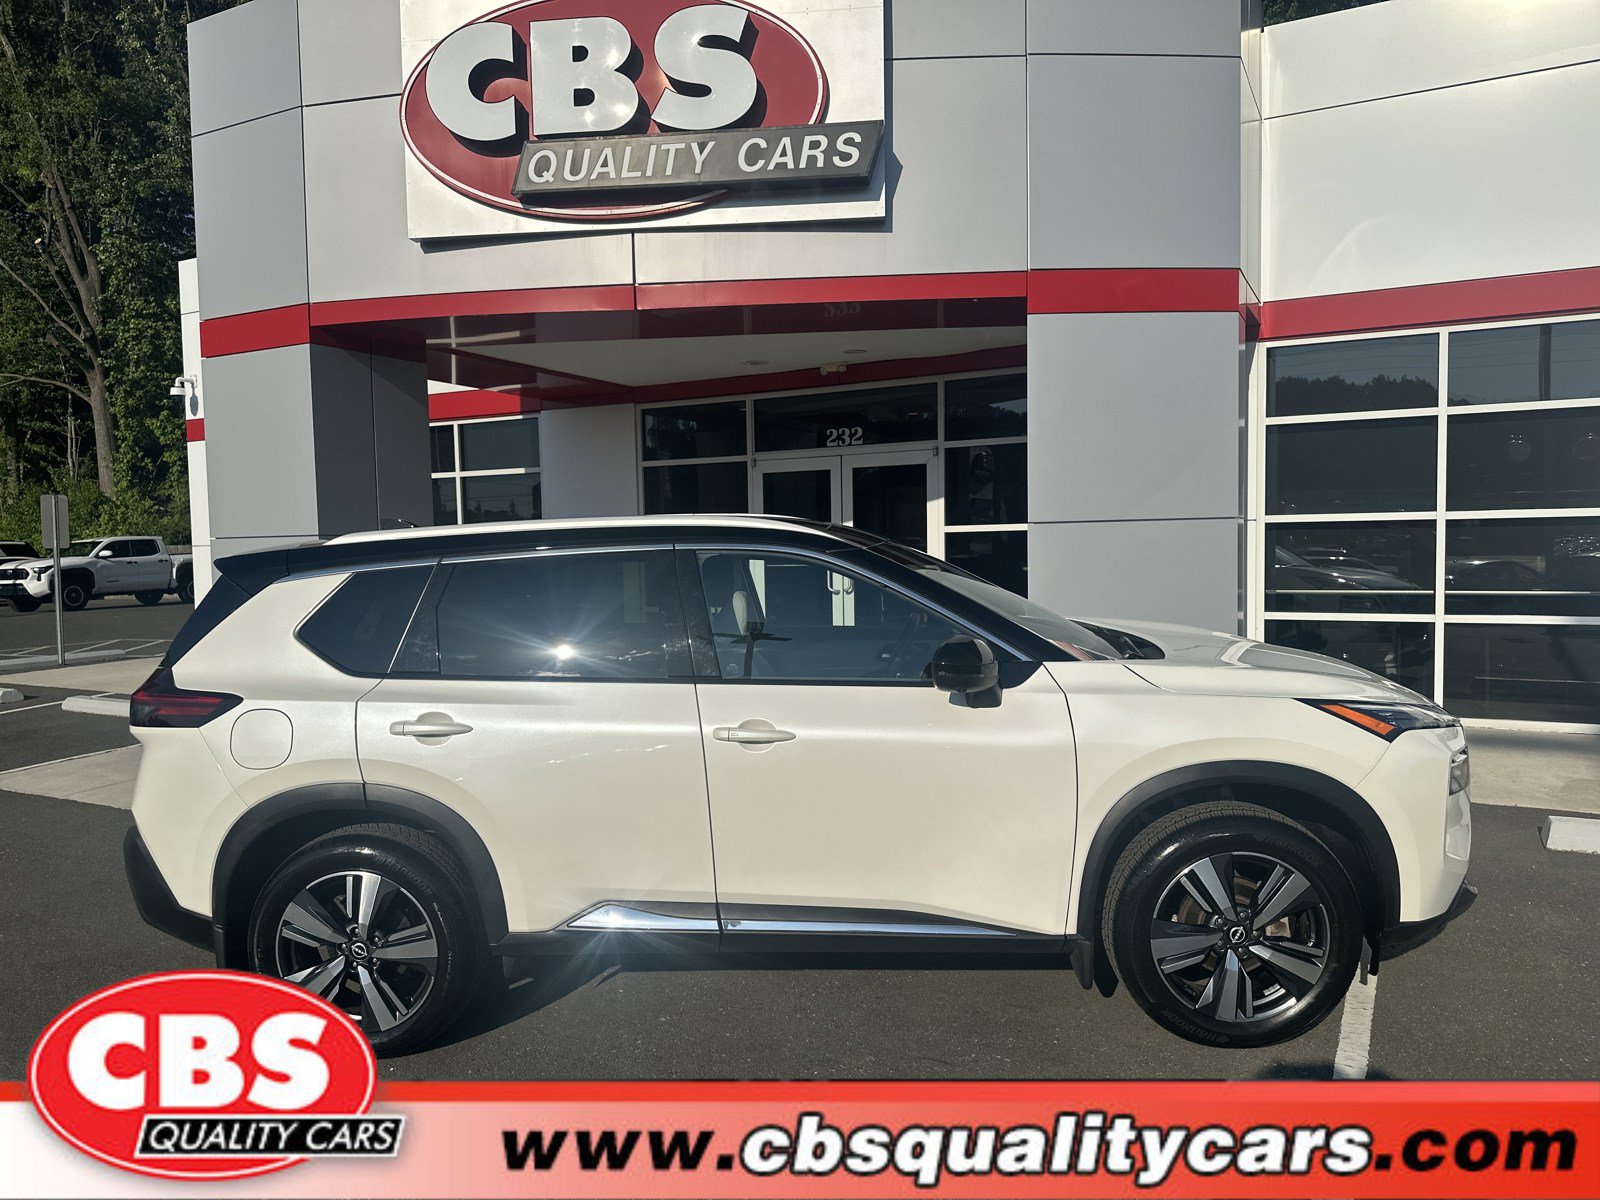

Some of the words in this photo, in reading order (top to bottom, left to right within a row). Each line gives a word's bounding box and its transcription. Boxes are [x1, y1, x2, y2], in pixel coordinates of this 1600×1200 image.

[425, 5, 758, 141] CBS
[527, 140, 716, 184] QUALITY
[737, 132, 863, 173] CARS
[826, 426, 863, 447] 232
